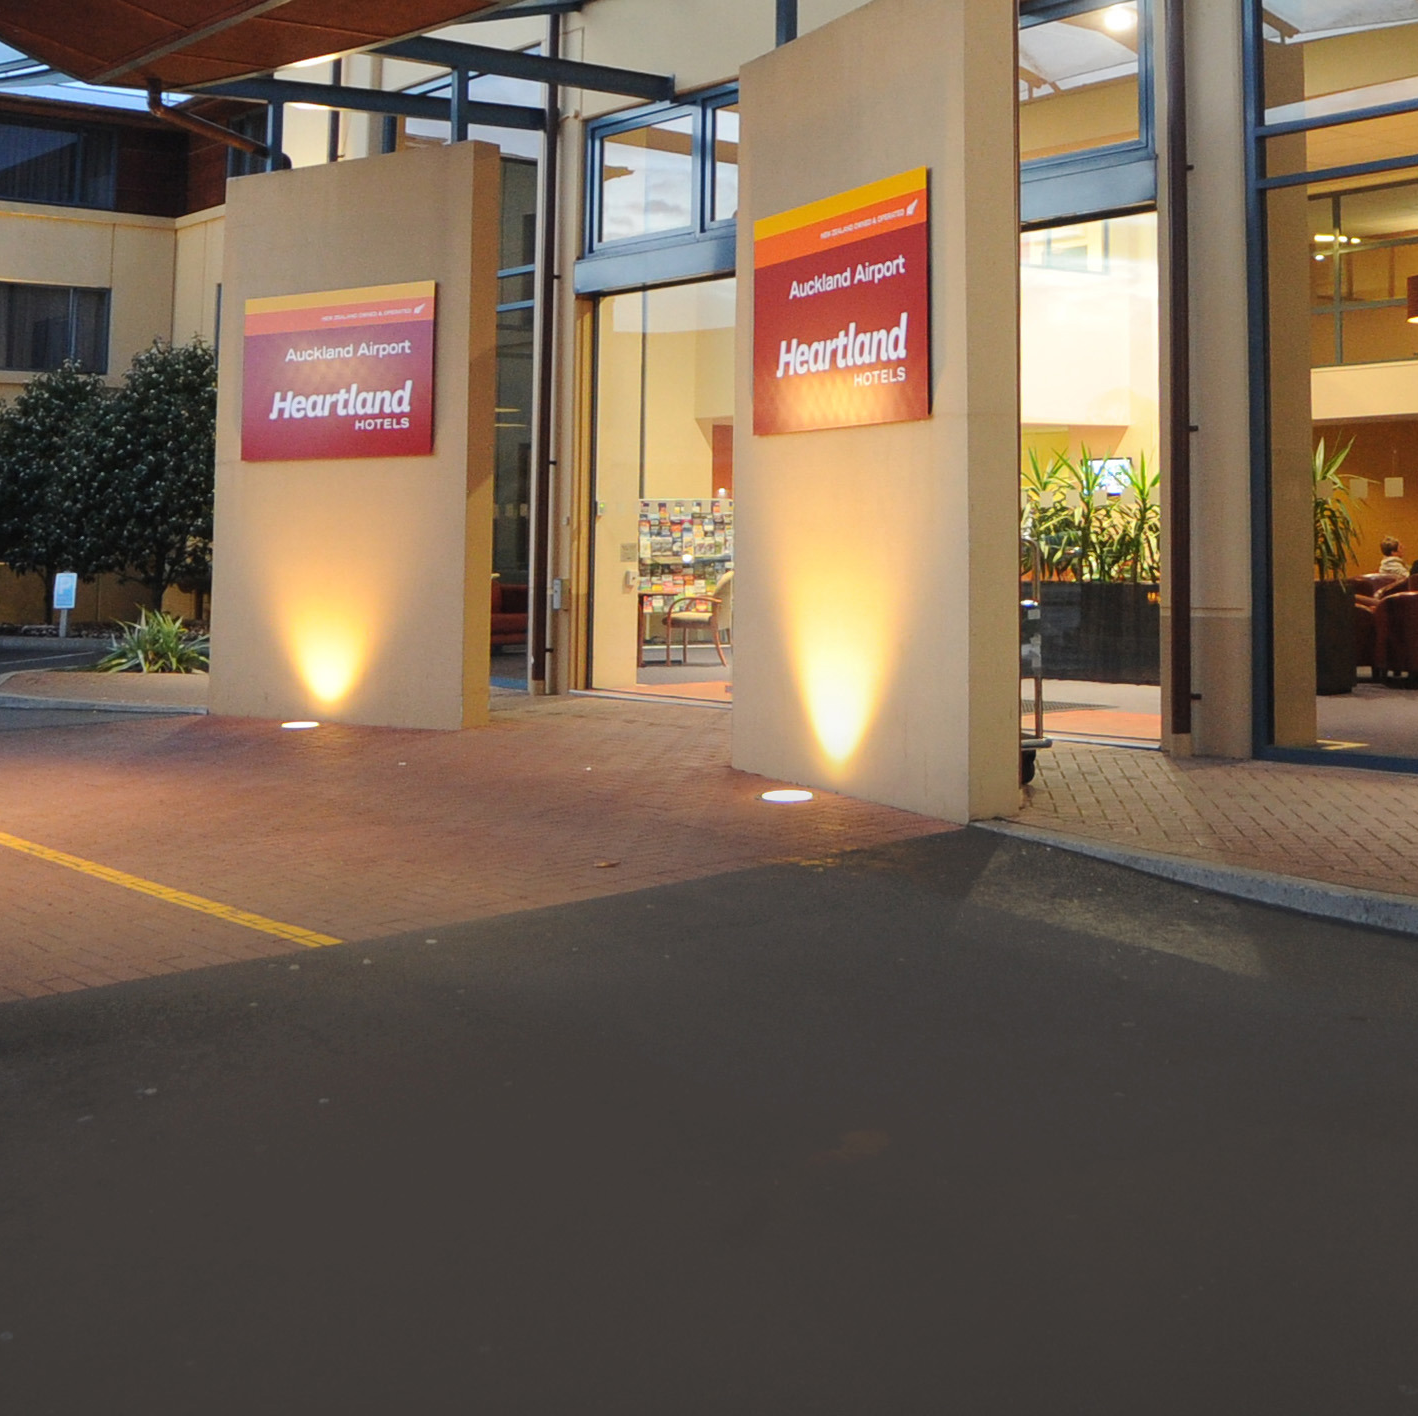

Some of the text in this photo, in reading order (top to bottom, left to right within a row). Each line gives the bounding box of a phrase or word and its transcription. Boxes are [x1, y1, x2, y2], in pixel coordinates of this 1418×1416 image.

[788, 254, 906, 300] Auckland Airport
[285, 339, 411, 362] Auckland Airport
[776, 312, 909, 378] Heartland
[853, 366, 906, 388] HOTELS
[268, 379, 413, 420] Heartland
[354, 417, 410, 430] HOTELS
[59, 577, 72, 595] P
